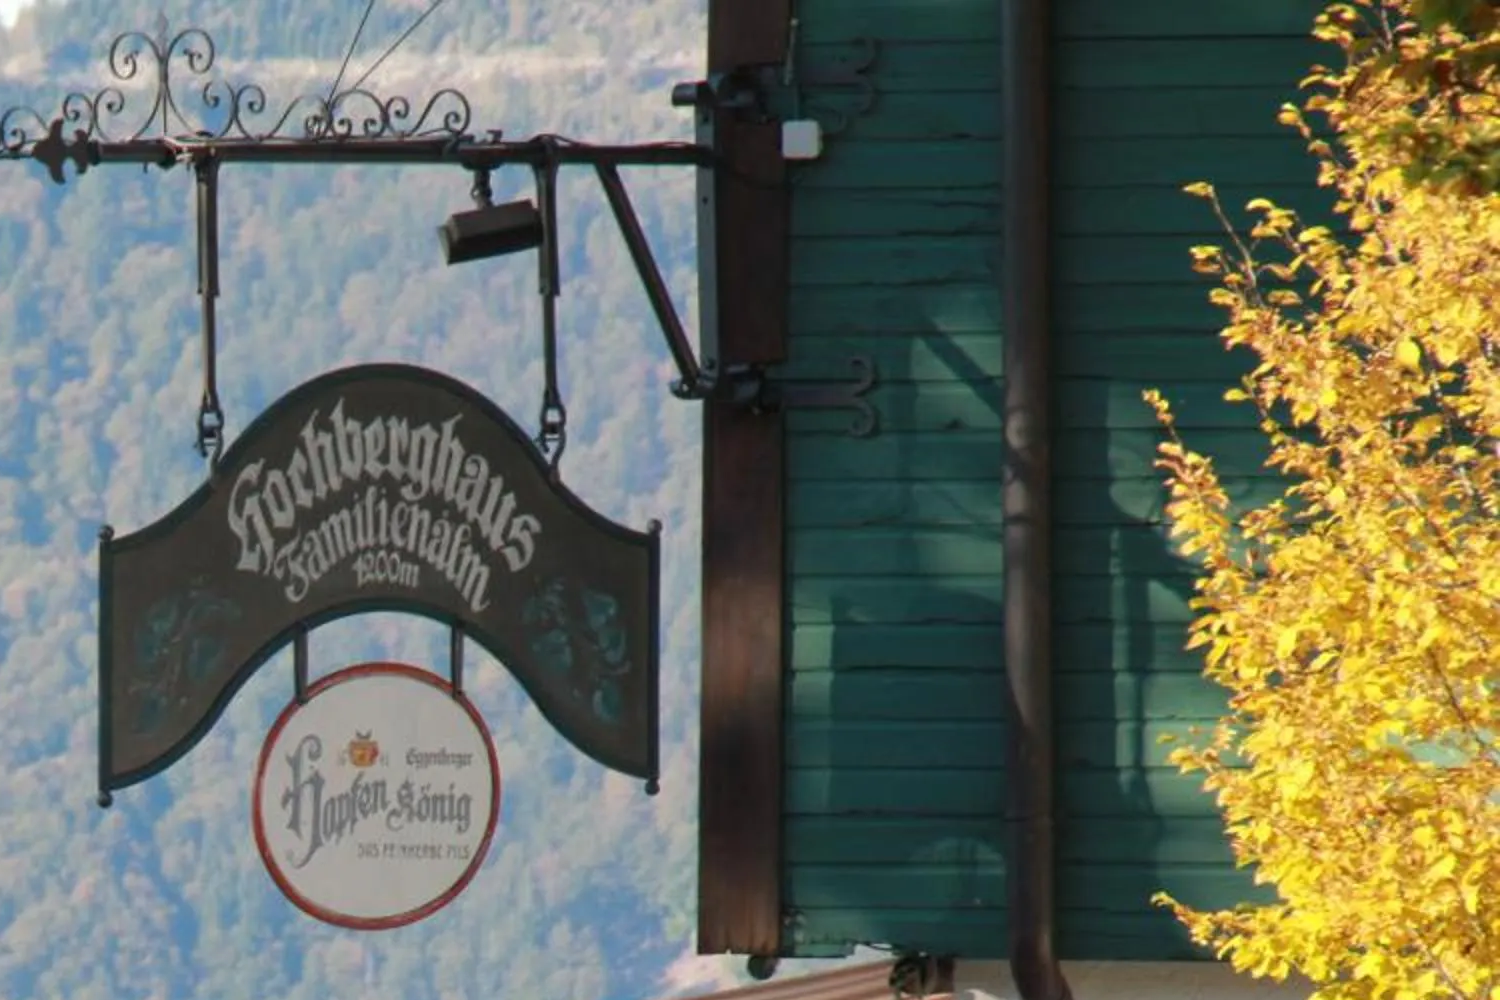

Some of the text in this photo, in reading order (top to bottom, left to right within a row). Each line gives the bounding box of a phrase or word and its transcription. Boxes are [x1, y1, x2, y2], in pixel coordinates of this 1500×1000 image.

[228, 397, 542, 576] Hochberghaus
[352, 550, 420, 589] 1200m
[281, 733, 473, 869] Hopfen König
